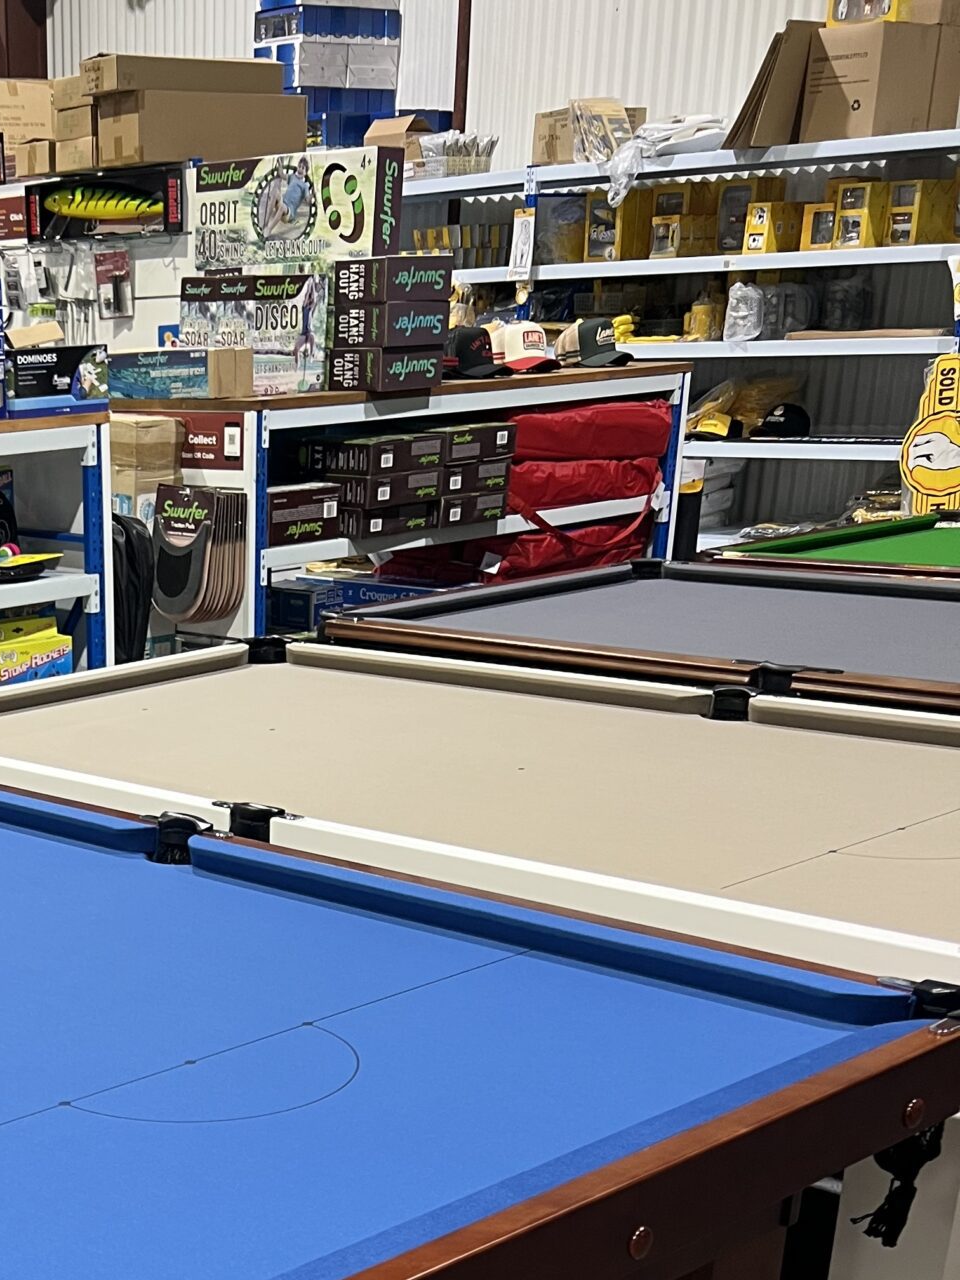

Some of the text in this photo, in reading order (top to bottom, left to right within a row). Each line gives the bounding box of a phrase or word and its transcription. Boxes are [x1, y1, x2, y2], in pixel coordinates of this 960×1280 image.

[199, 162, 245, 187] Swurfer
[200, 200, 239, 226] ORBIT
[379, 158, 398, 246] Swurfer
[185, 283, 213, 297] Swurfer
[220, 282, 248, 296] Swurfer
[255, 278, 300, 299] Swurfer
[339, 270, 349, 295] OUT
[348, 264, 359, 300] HANG
[394, 265, 446, 292] Swurfer
[255, 304, 299, 331] DISCO
[338, 315, 348, 339] OUT
[348, 309, 359, 345] HANG
[395, 310, 444, 337] Swurfer
[185, 330, 209, 347] SOAR
[221, 330, 245, 346] SOAR
[17, 353, 58, 364] DOMINOES
[137, 352, 169, 366] Swurfer
[333, 358, 344, 382] OUT
[343, 353, 354, 387] HANG
[389, 355, 437, 381] Swurfer
[938, 367, 956, 406] SOLD
[188, 434, 217, 445] Collect
[162, 500, 208, 523] Swurfer
[286, 521, 324, 540] Swurfer
[0, 644, 69, 681] STOMP ROCKETS
